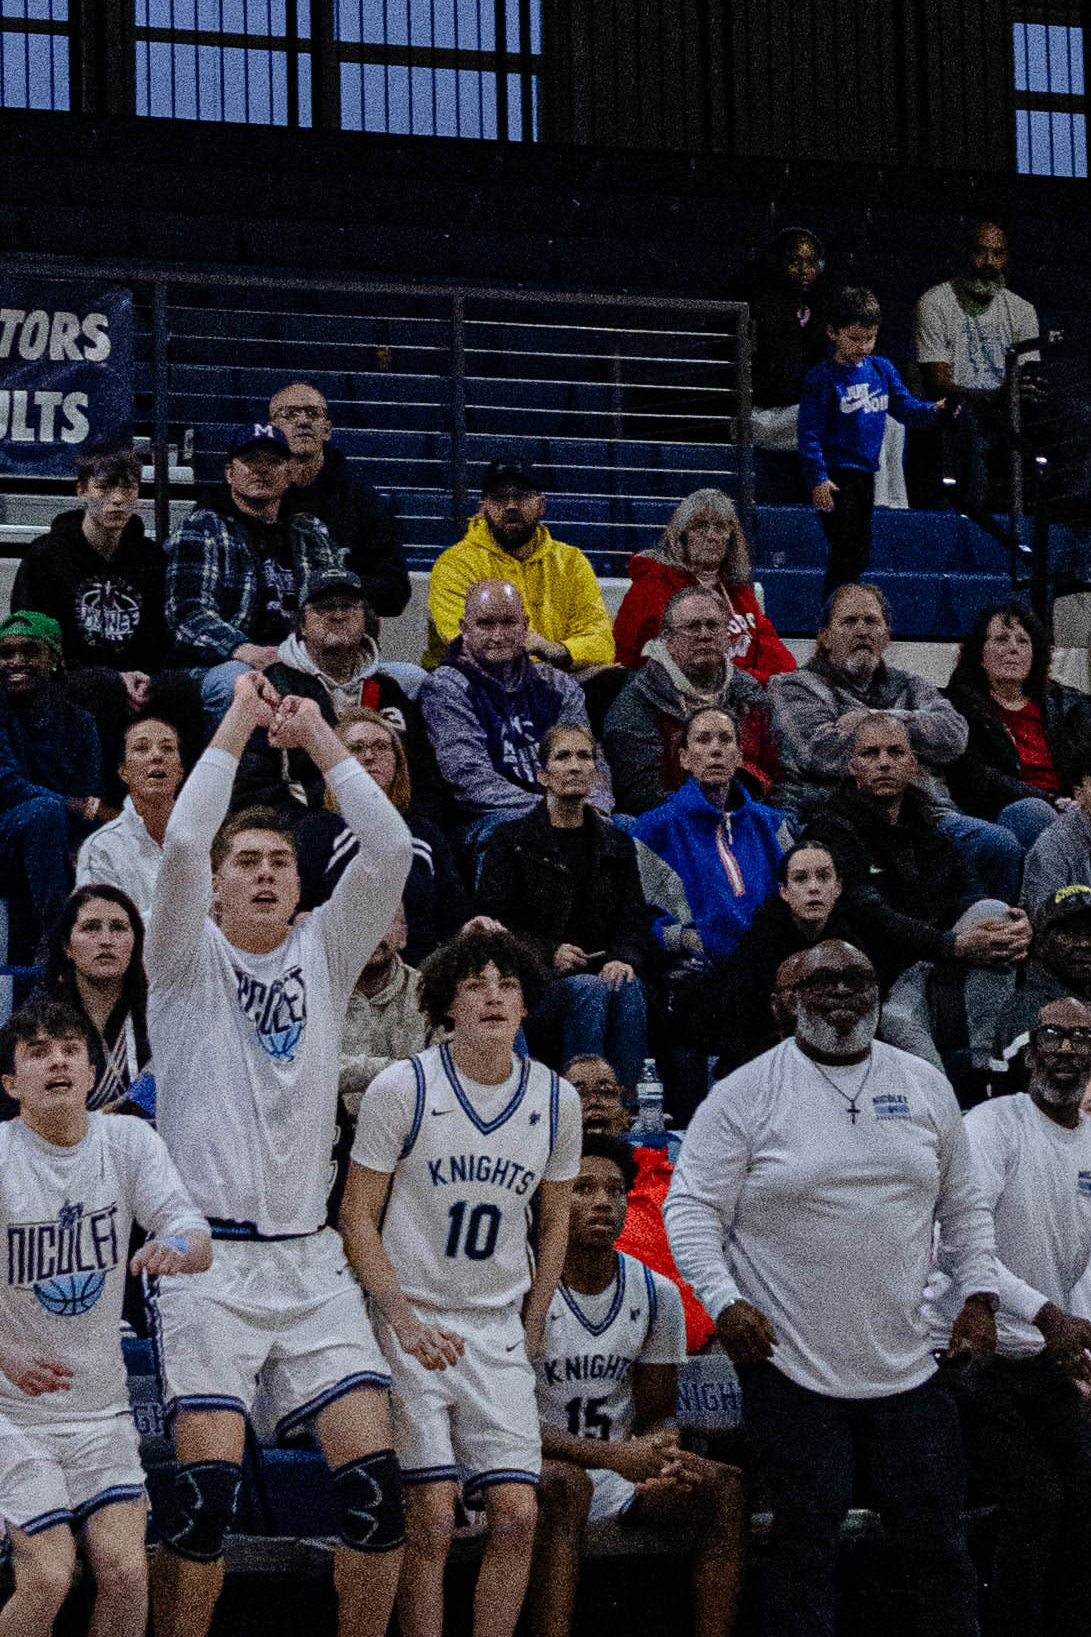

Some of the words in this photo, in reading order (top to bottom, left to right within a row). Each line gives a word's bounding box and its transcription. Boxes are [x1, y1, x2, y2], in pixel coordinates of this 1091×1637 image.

[253, 423, 275, 438] M
[428, 1154, 535, 1196] KNIGHTS
[8, 1207, 118, 1284] NICOLET
[445, 1200, 502, 1261] 10
[565, 1396, 612, 1441] 15
